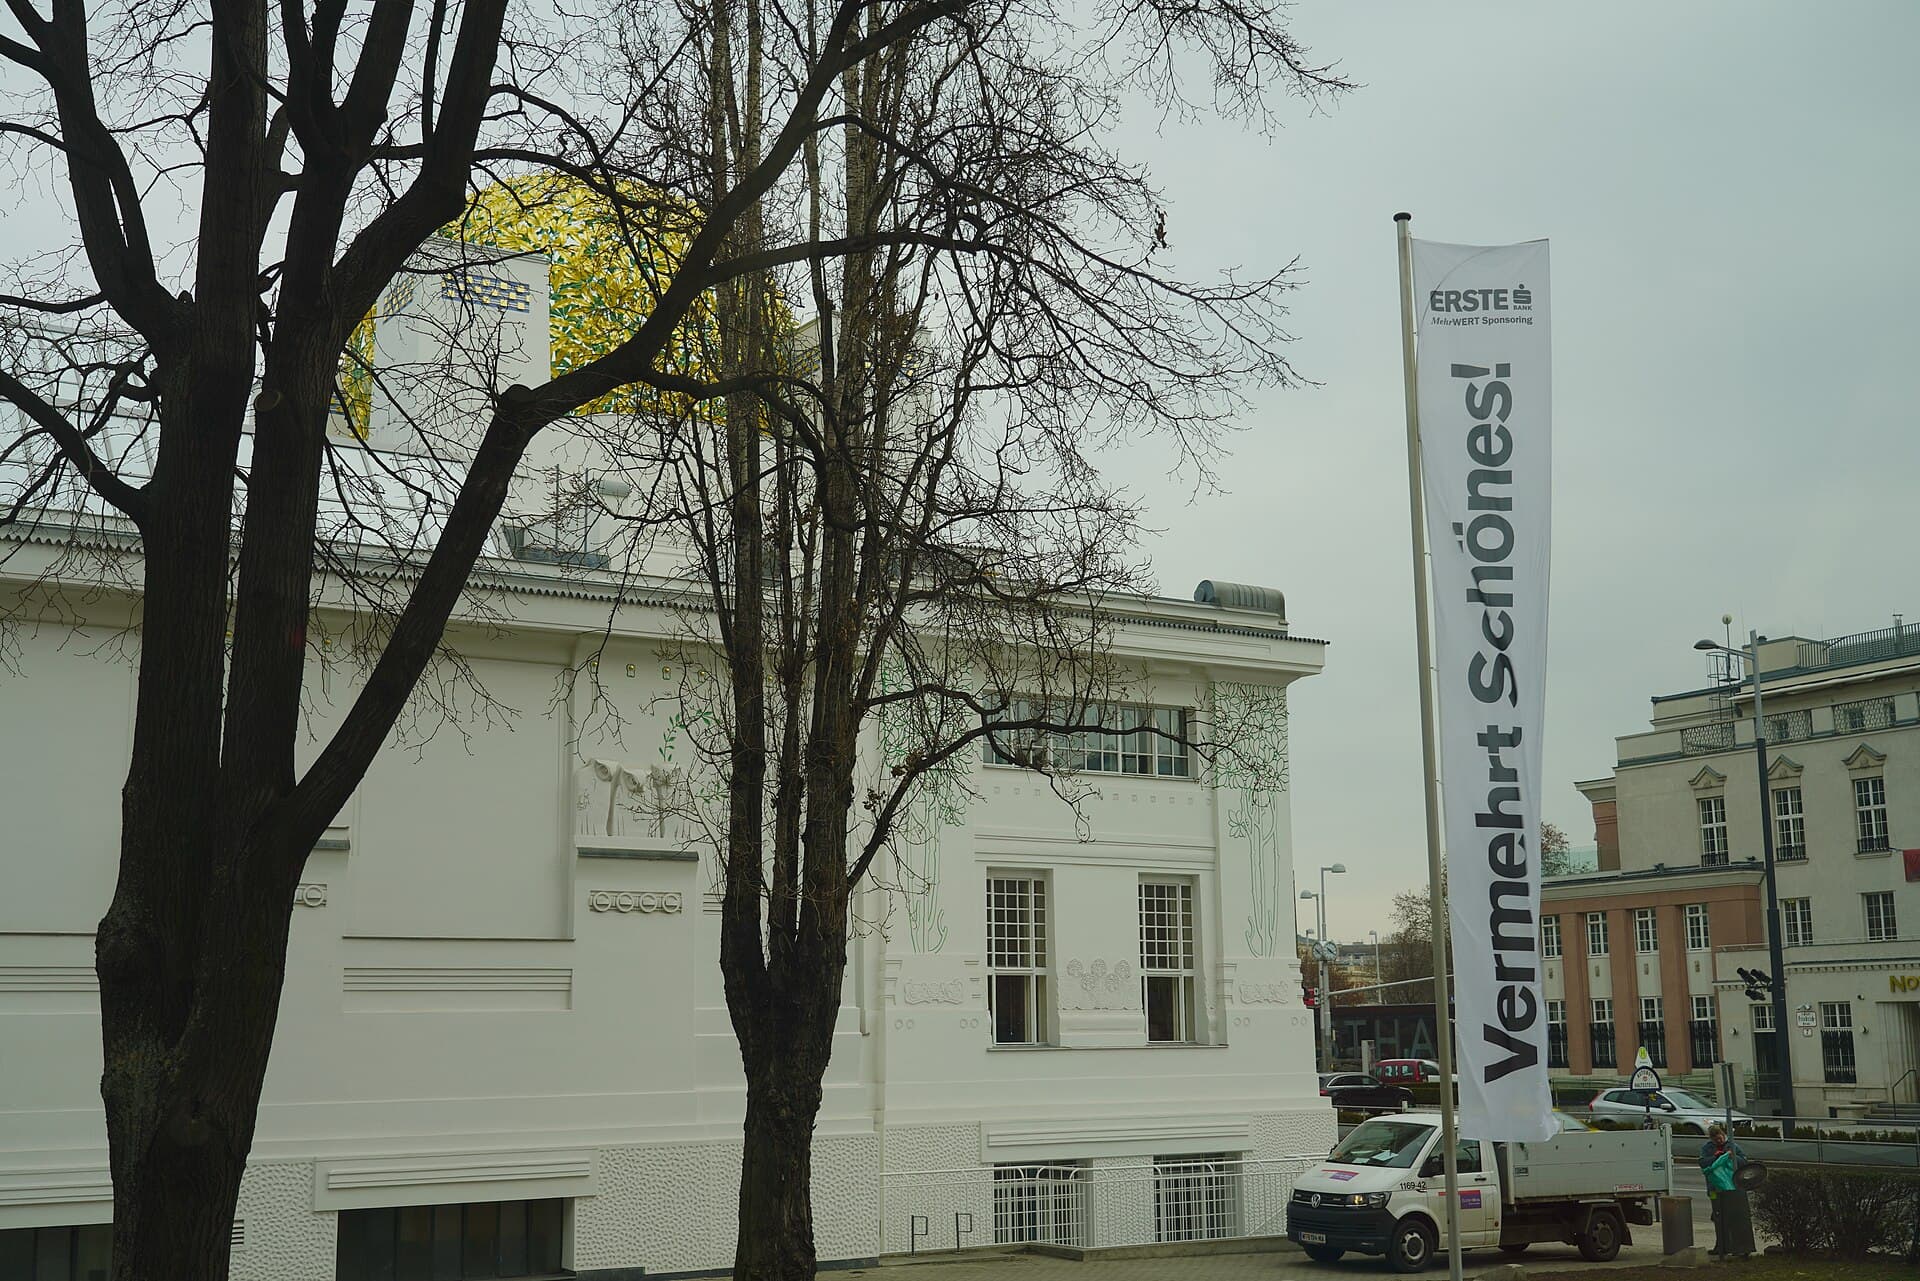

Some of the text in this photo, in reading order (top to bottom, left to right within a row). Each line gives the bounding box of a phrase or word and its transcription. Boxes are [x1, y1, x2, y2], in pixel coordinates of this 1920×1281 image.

[1429, 289, 1509, 313] ERSTE
[1431, 315, 1533, 326] MehrWERT Sponsoring
[1450, 362, 1538, 1084] Vermehrt Schönes!
